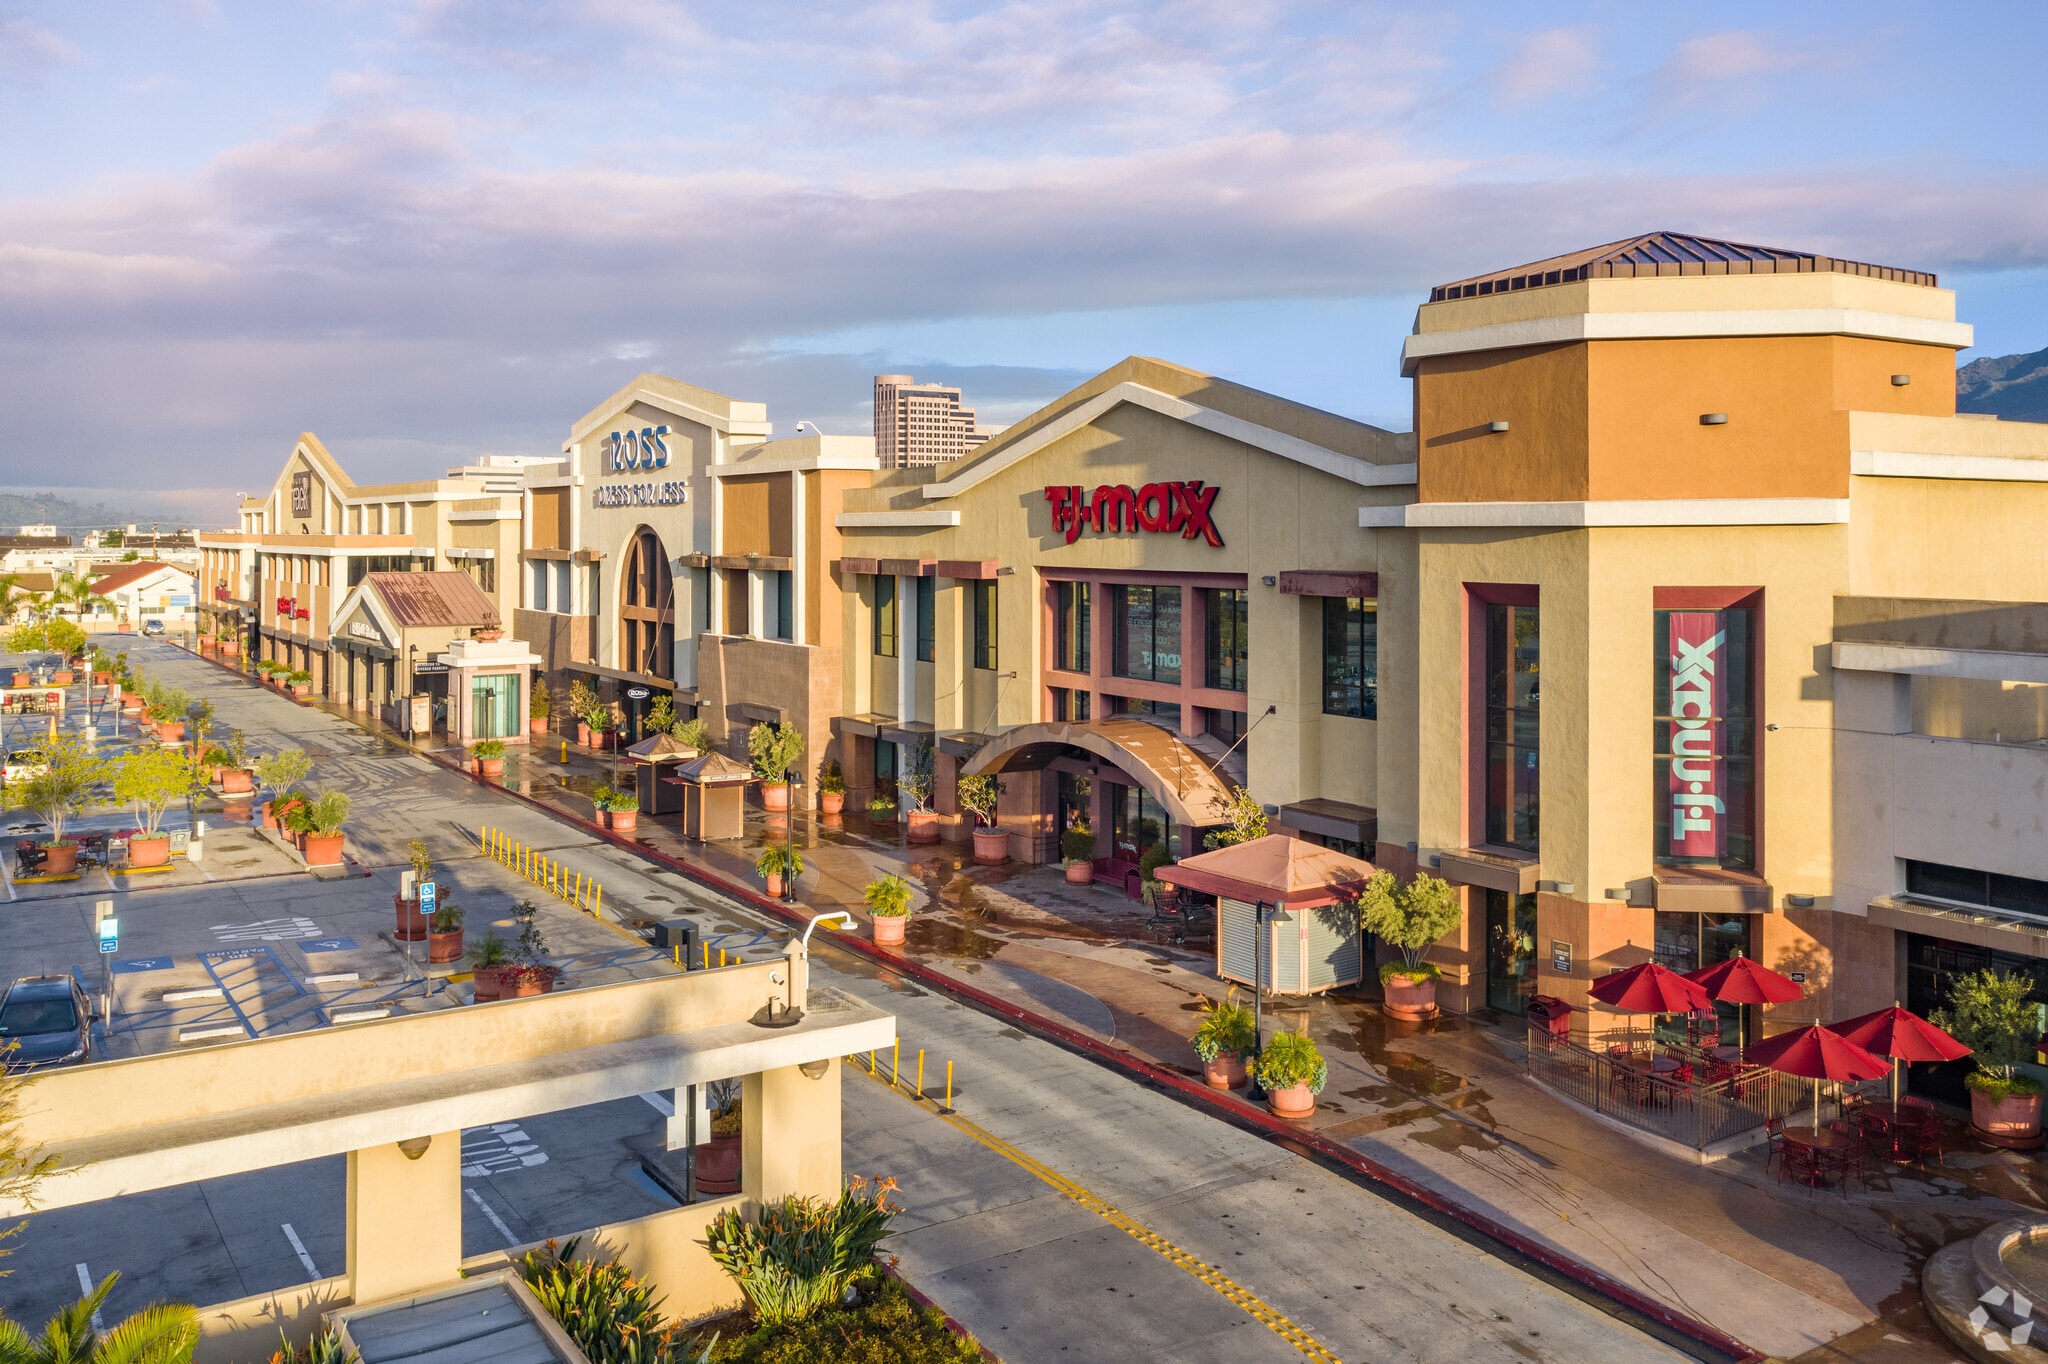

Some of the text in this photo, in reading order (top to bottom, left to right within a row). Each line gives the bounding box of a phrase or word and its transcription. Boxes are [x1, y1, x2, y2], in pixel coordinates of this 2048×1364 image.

[609, 425, 672, 471] ROSS
[599, 481, 689, 507] DRESS FOR LESS
[206, 947, 265, 958] PARKING
